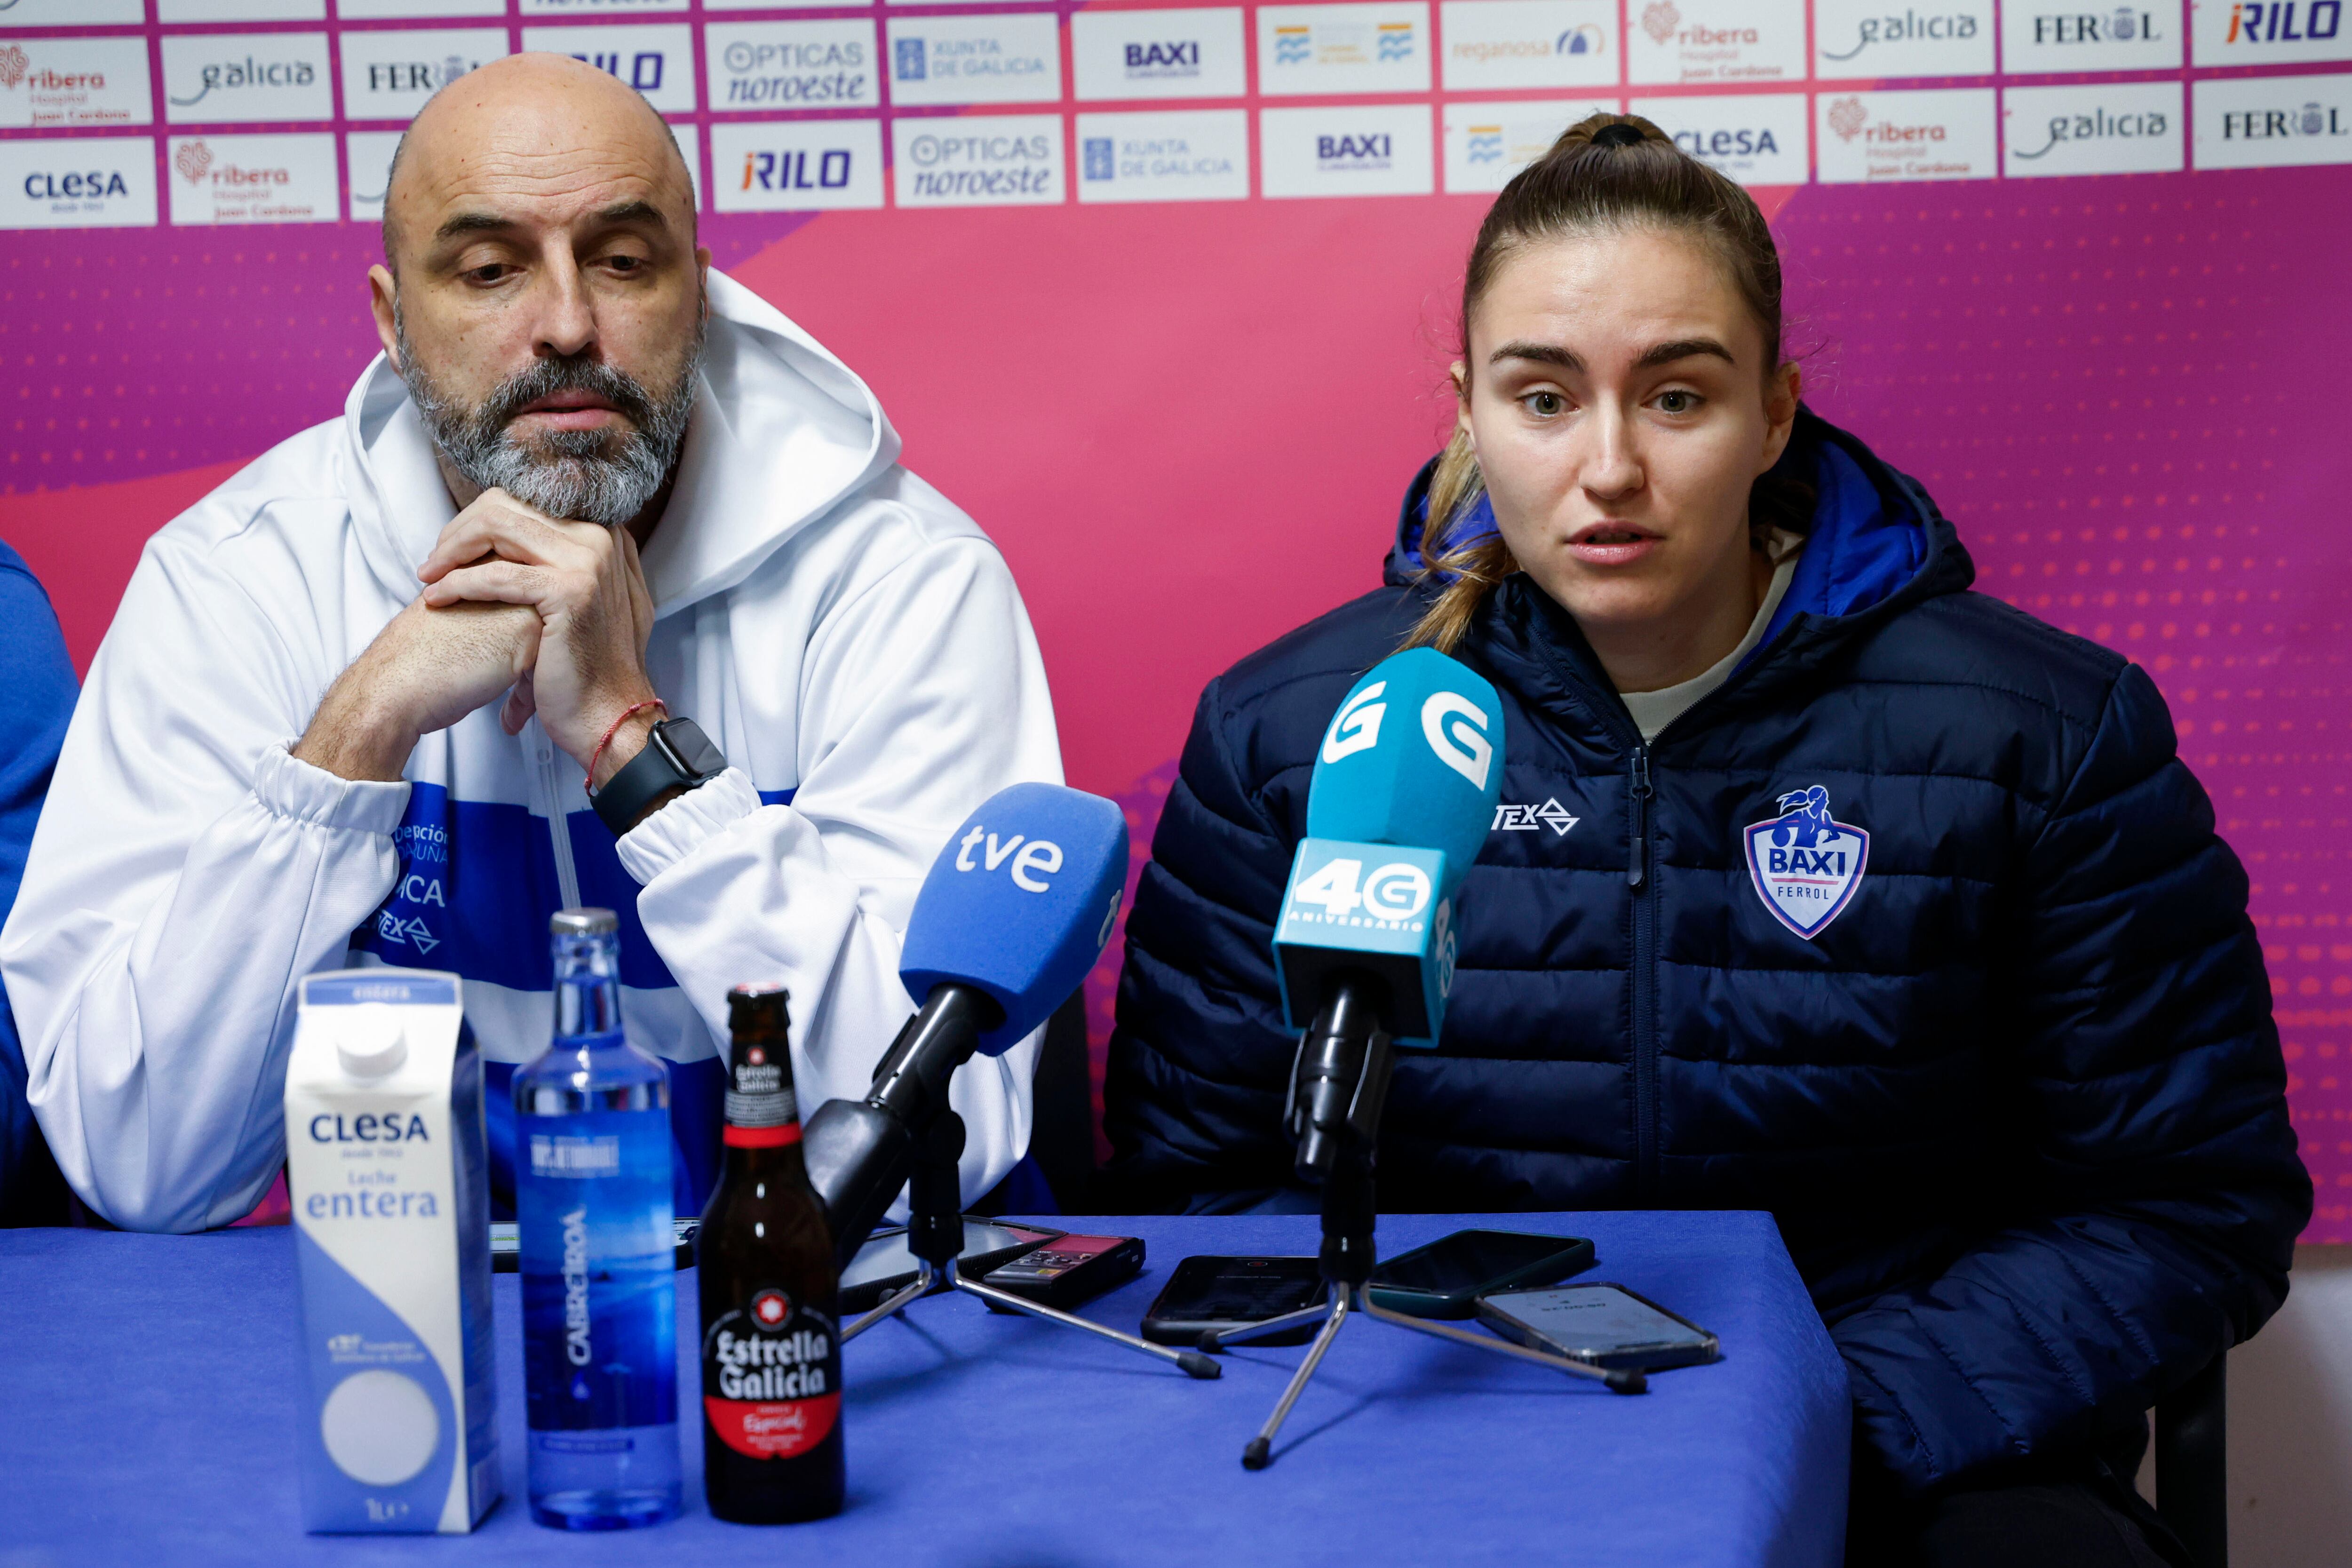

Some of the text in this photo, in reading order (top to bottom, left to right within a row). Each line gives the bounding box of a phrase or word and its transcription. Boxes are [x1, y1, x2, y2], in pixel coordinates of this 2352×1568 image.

[1678, 24, 1758, 44] ribera
[1823, 9, 1977, 60] galicia
[1126, 41, 1199, 66] BAXI
[29, 68, 105, 90] ribera
[170, 55, 315, 105] galicia
[729, 72, 865, 102] noroeste
[1866, 121, 1946, 142] ribera
[2014, 108, 2167, 159] galicia
[1318, 134, 1391, 158] BAXI
[212, 165, 289, 185] ribera
[914, 166, 1051, 196] noroeste
[955, 825, 1064, 893] tve
[1769, 848, 1846, 876] BAXI
[1778, 886, 1829, 900] FERROL
[1287, 910, 1424, 933] ANIVERSARIO
[352, 986, 411, 1000] entera
[307, 1187, 438, 1219] entera
[715, 1330, 828, 1365] Estrella
[719, 1363, 826, 1400] Galicia
